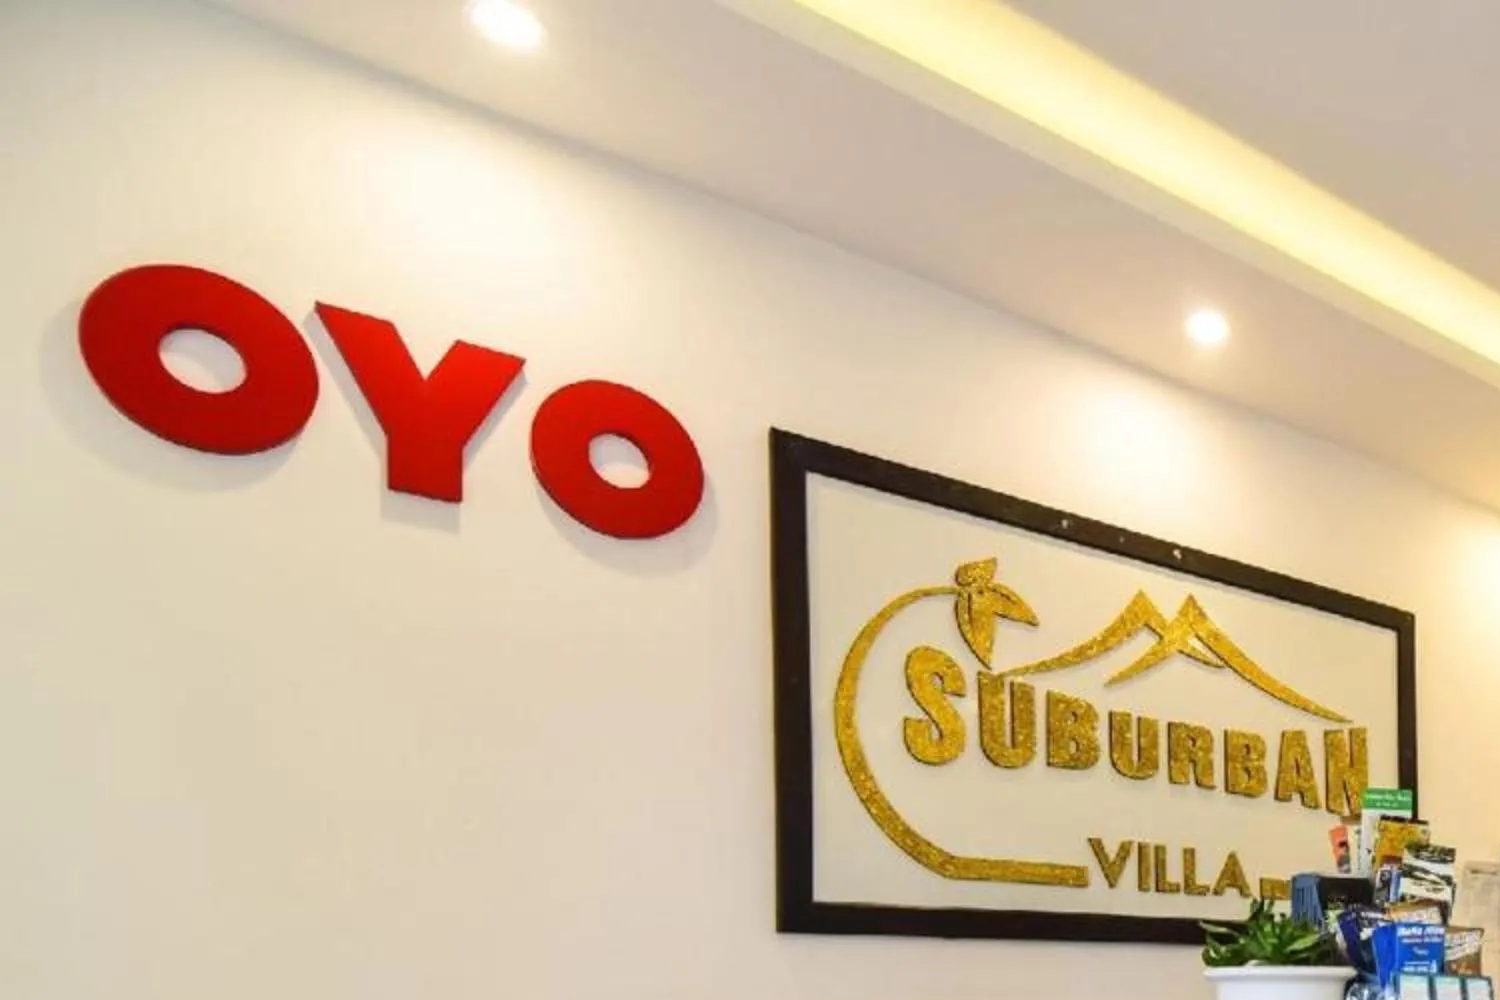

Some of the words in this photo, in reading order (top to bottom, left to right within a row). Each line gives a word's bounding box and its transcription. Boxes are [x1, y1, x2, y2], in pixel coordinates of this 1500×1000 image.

[78, 264, 704, 540] OYO
[903, 645, 1368, 816] SUBURBAN
[1088, 837, 1252, 898] VILLA
